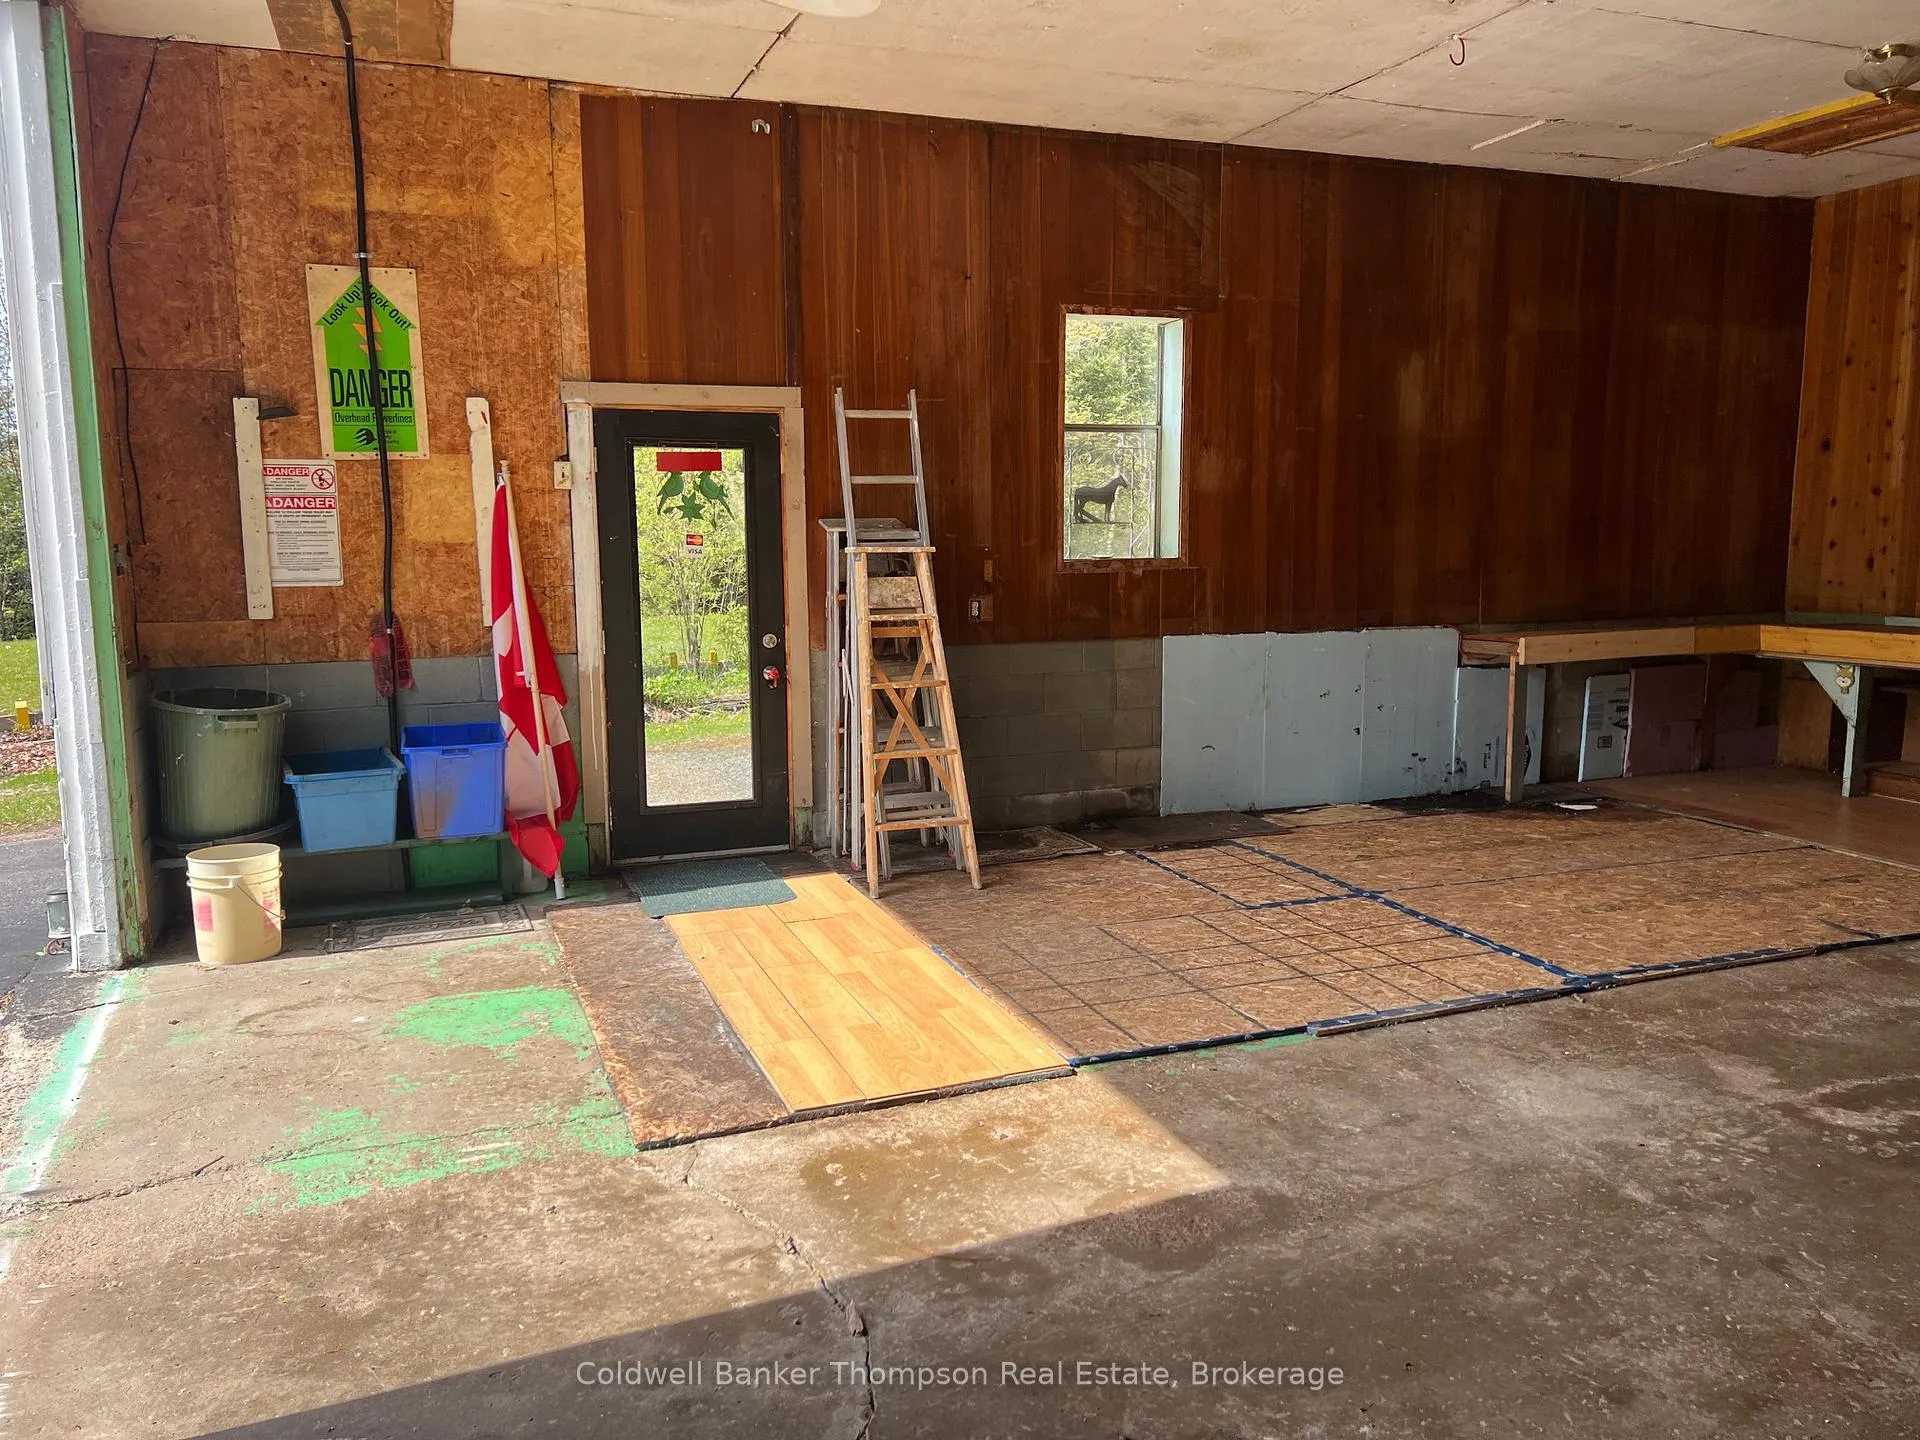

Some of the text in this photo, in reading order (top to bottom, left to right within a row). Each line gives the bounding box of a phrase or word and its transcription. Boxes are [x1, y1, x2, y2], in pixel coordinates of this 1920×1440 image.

[322, 284, 412, 332] Look Up! ook Out!
[329, 368, 413, 408] DANGER
[334, 411, 371, 423] Overhead
[266, 467, 309, 476] DANGER
[272, 497, 335, 508] DANGER
